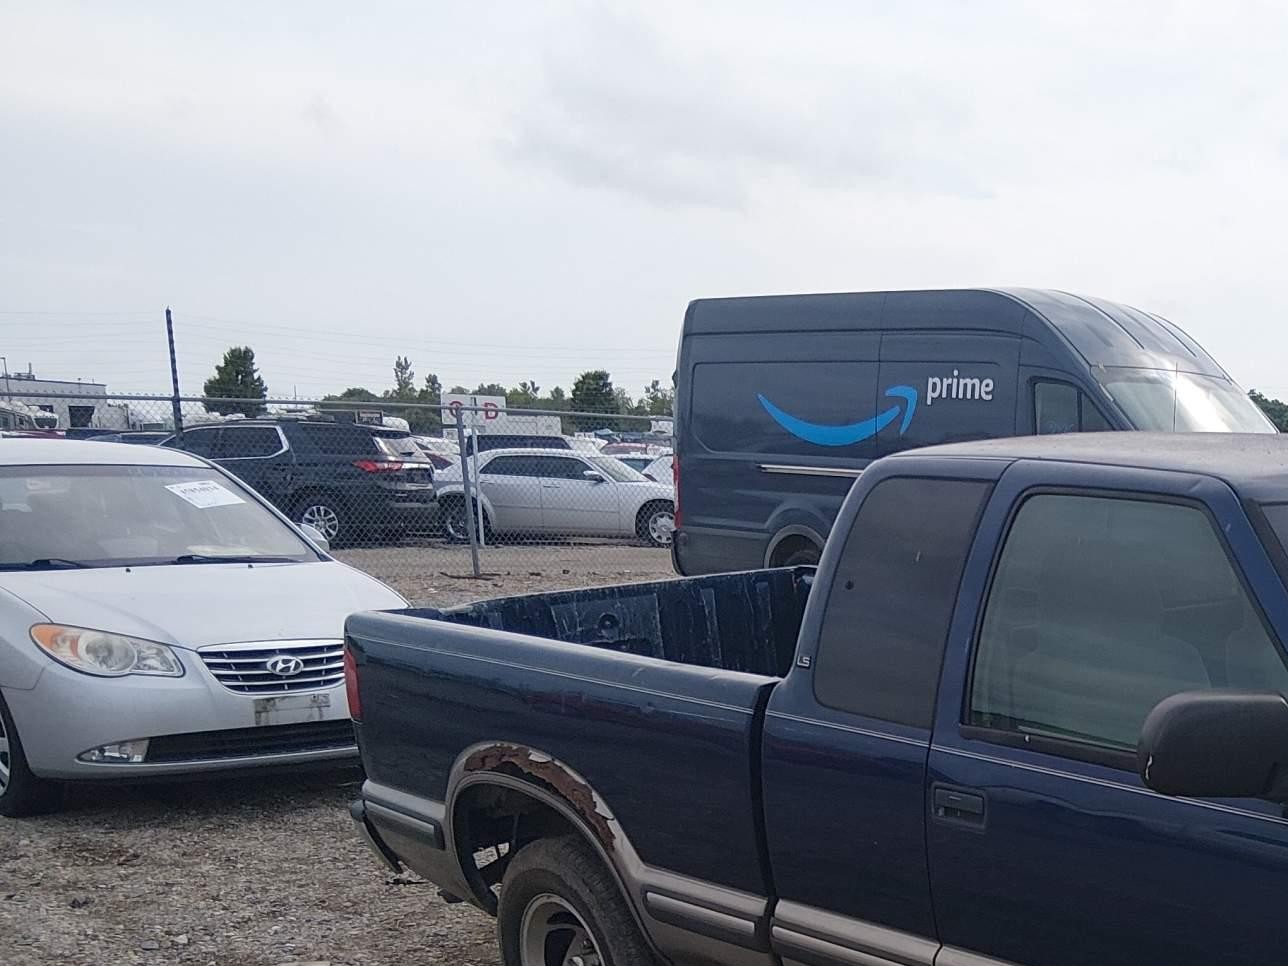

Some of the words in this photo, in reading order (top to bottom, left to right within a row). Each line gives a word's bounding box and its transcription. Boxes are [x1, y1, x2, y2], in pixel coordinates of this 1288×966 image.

[926, 369, 994, 405] prime
[484, 402, 499, 420] D
[796, 655, 810, 667] LS
